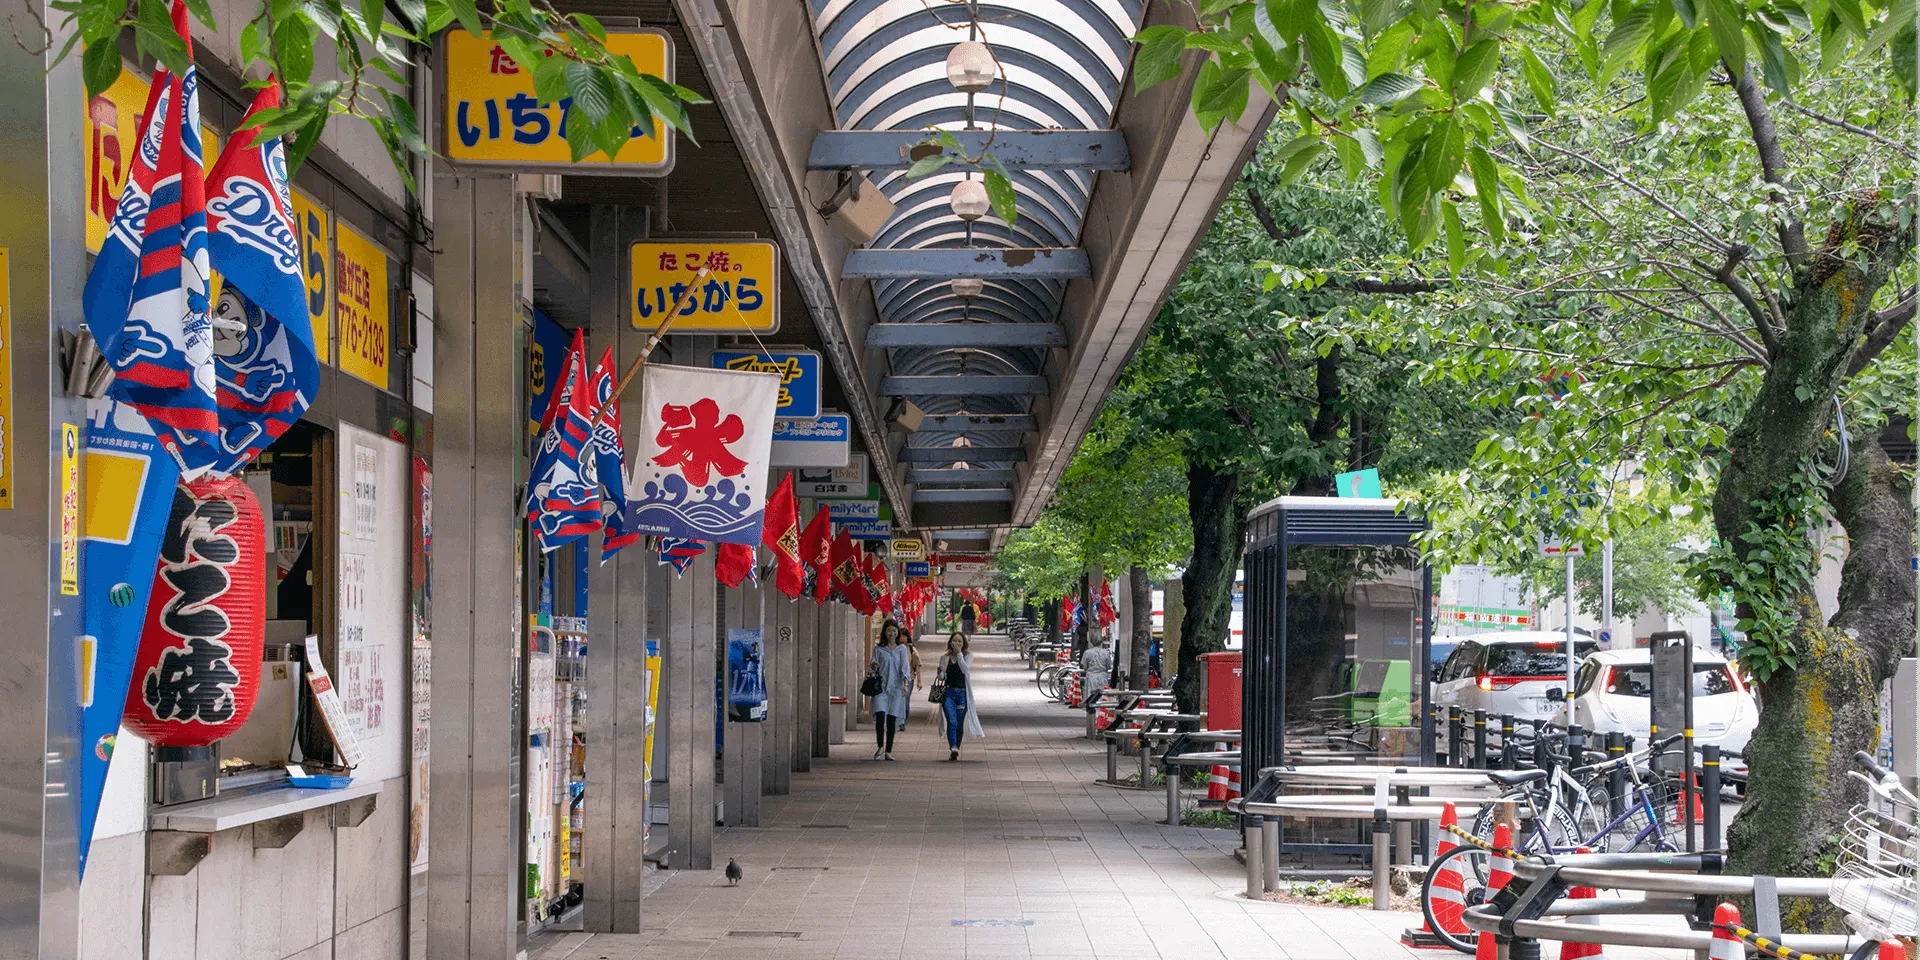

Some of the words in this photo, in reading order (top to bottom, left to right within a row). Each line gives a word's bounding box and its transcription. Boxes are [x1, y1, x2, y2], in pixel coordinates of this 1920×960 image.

[457, 92, 645, 147] いち
[658, 250, 743, 273] たこ焼の
[637, 277, 764, 319] いちから
[338, 300, 385, 368] 776-2139
[650, 397, 750, 488] 氷
[818, 503, 876, 515] FmilyMart
[142, 484, 240, 725] たこ焼
